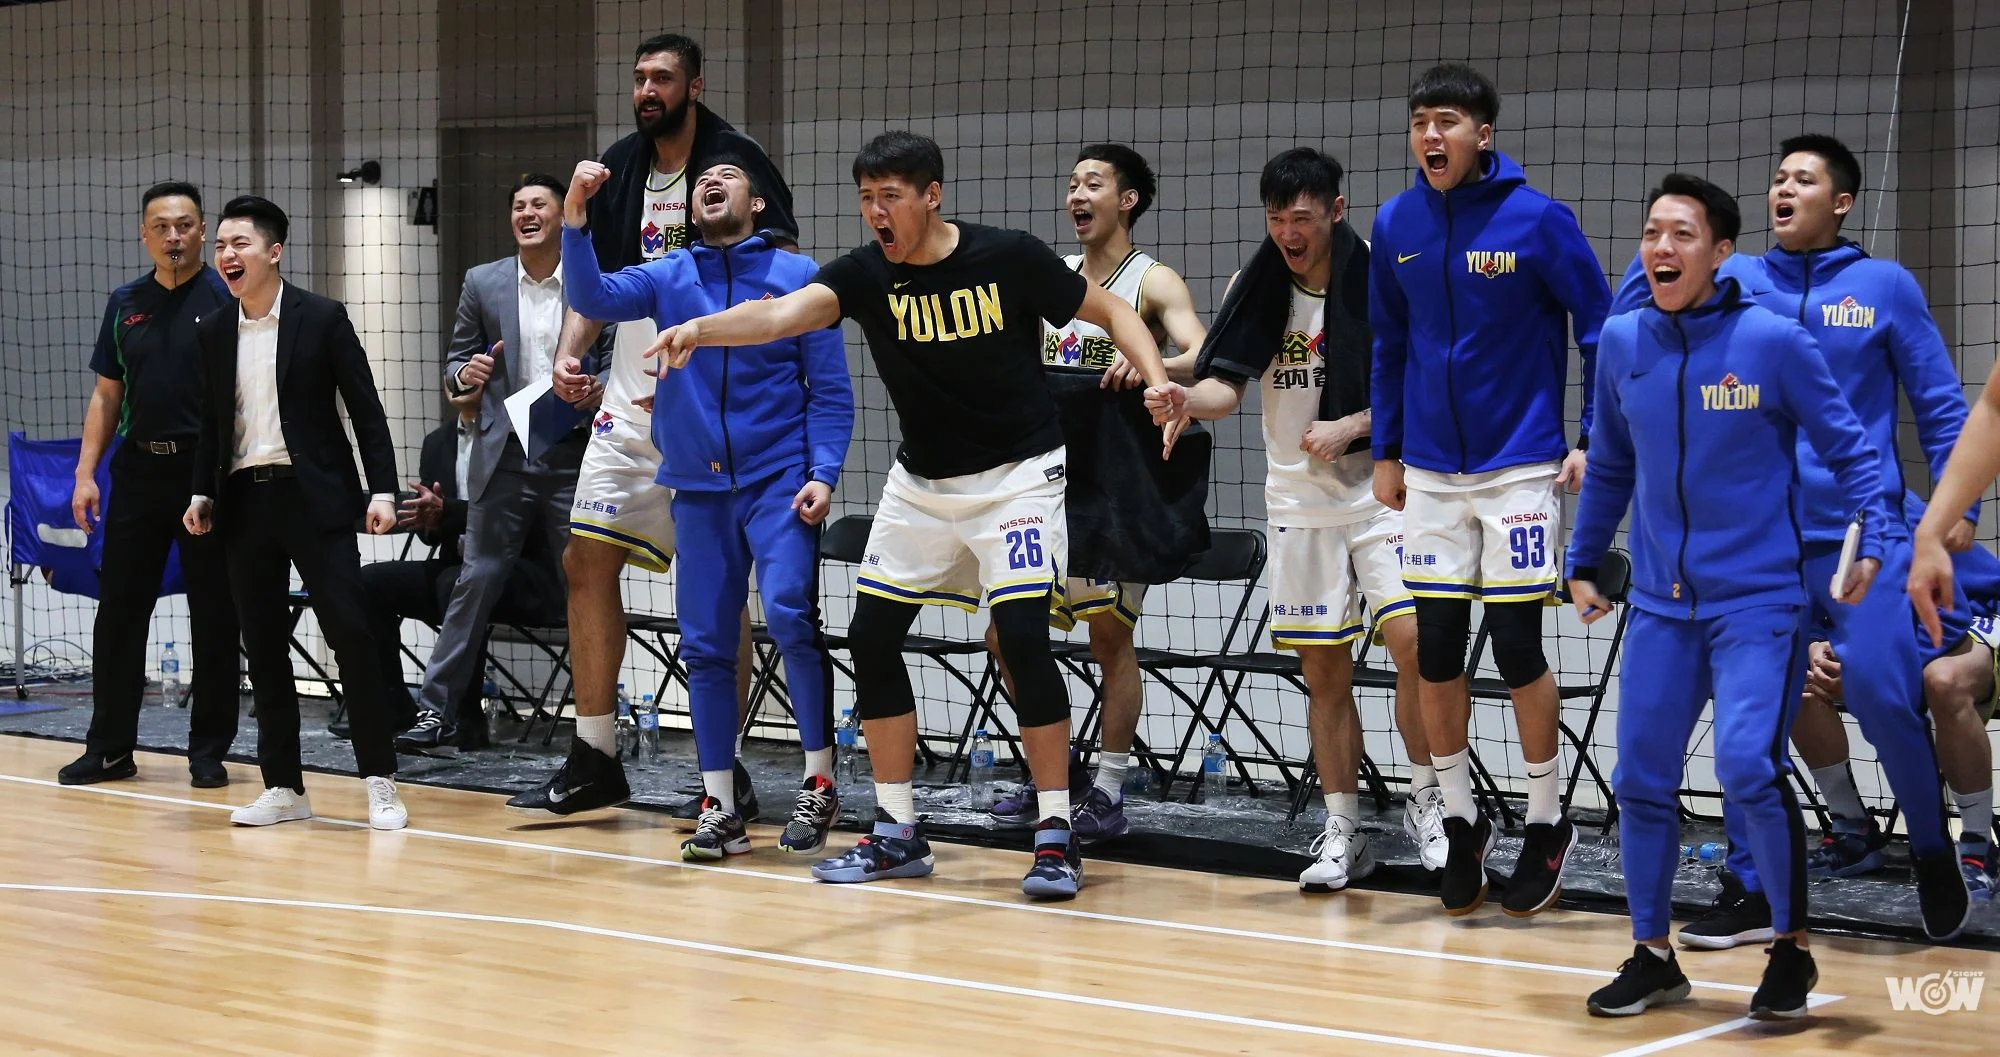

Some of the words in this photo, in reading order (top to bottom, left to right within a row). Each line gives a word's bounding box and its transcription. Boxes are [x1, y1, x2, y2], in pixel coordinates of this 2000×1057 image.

[652, 203, 688, 211] NISSA
[888, 283, 1004, 342] YULON
[1700, 384, 1760, 411] YULON
[1000, 516, 1044, 532] NISSAN
[1501, 512, 1548, 525] NISSAN
[1005, 528, 1044, 570] 26
[1510, 525, 1545, 569] 93
[1274, 604, 1328, 616] 格上租車
